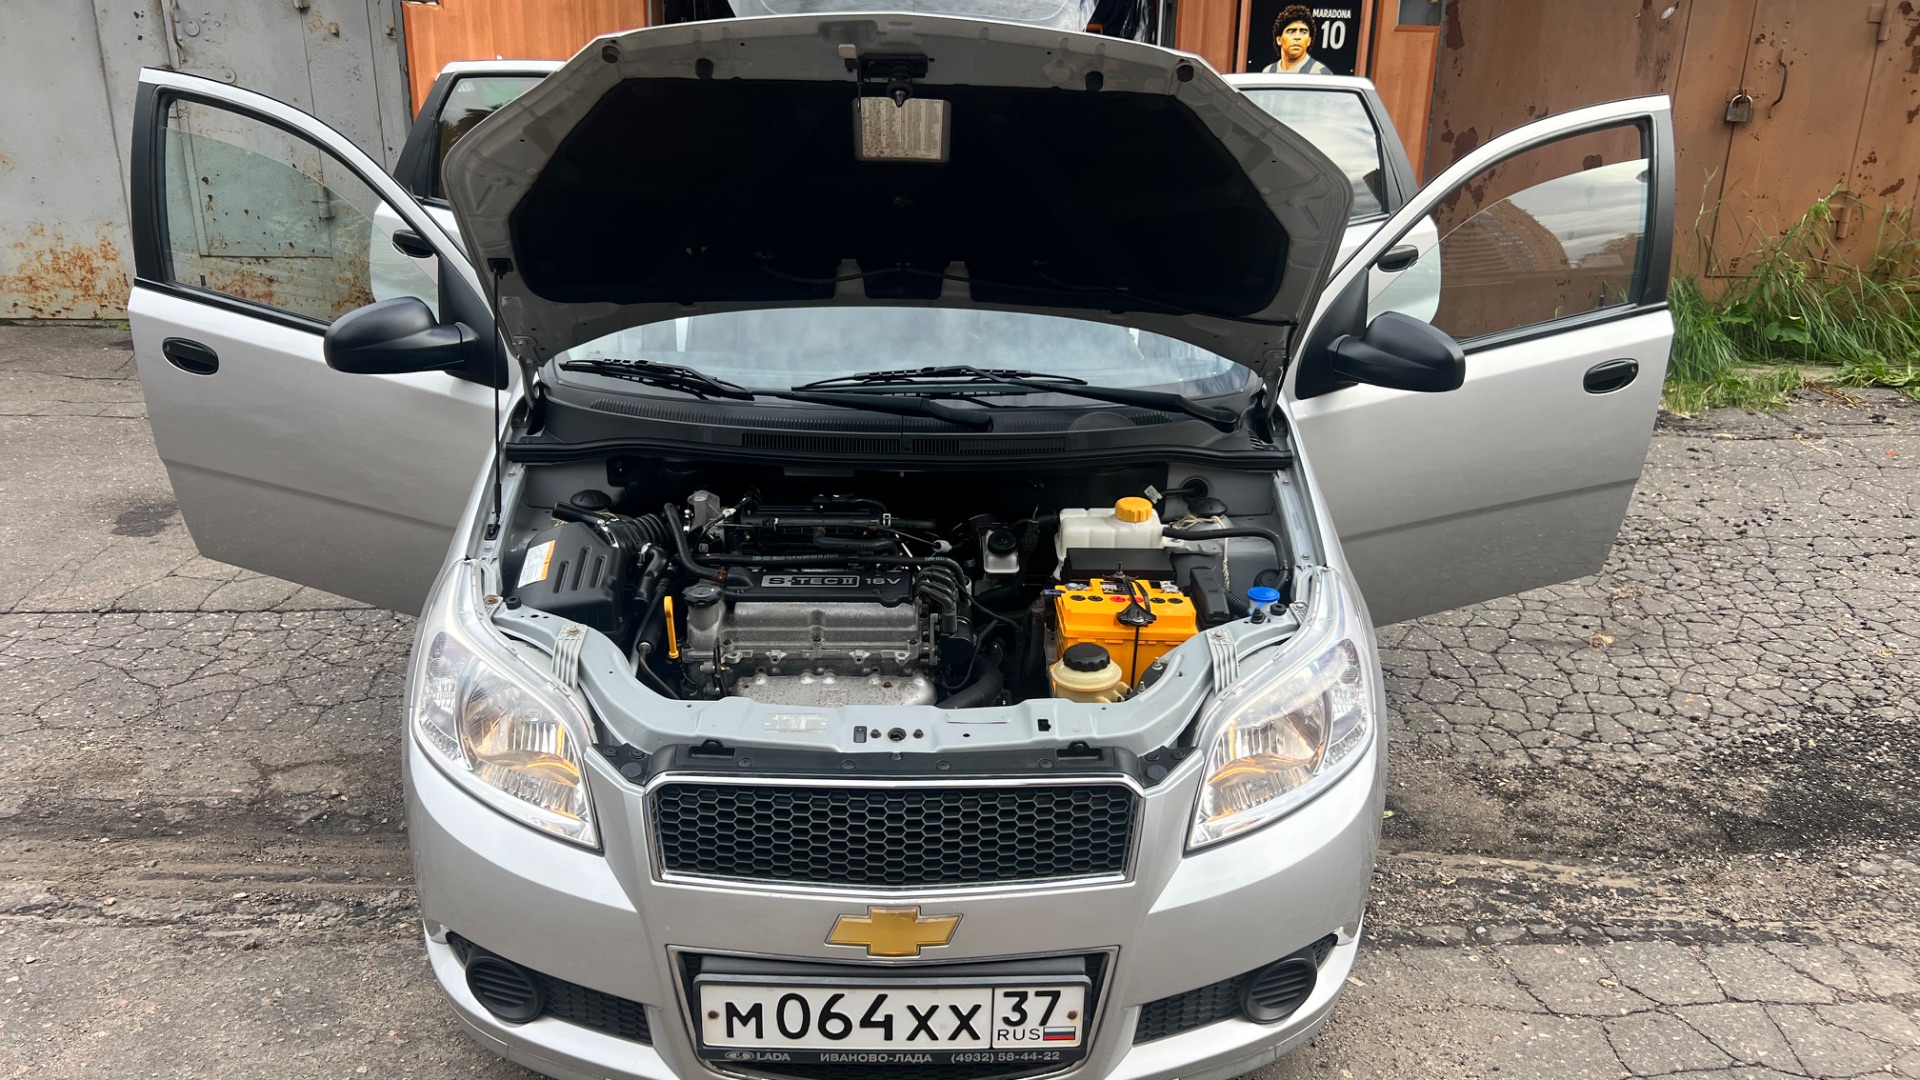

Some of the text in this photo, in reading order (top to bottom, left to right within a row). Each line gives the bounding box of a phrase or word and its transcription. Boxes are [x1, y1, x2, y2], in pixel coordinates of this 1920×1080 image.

[1312, 8, 1351, 19] MARADONA
[1321, 20, 1346, 50] 10
[1002, 990, 1061, 1027] 37
[725, 992, 982, 1041] М064ХХ
[997, 1028, 1041, 1041] RUS
[756, 1052, 791, 1061] LADA
[820, 1051, 1060, 1063] ИВАНОВО-ЛАДА (4932) 58-44-22
